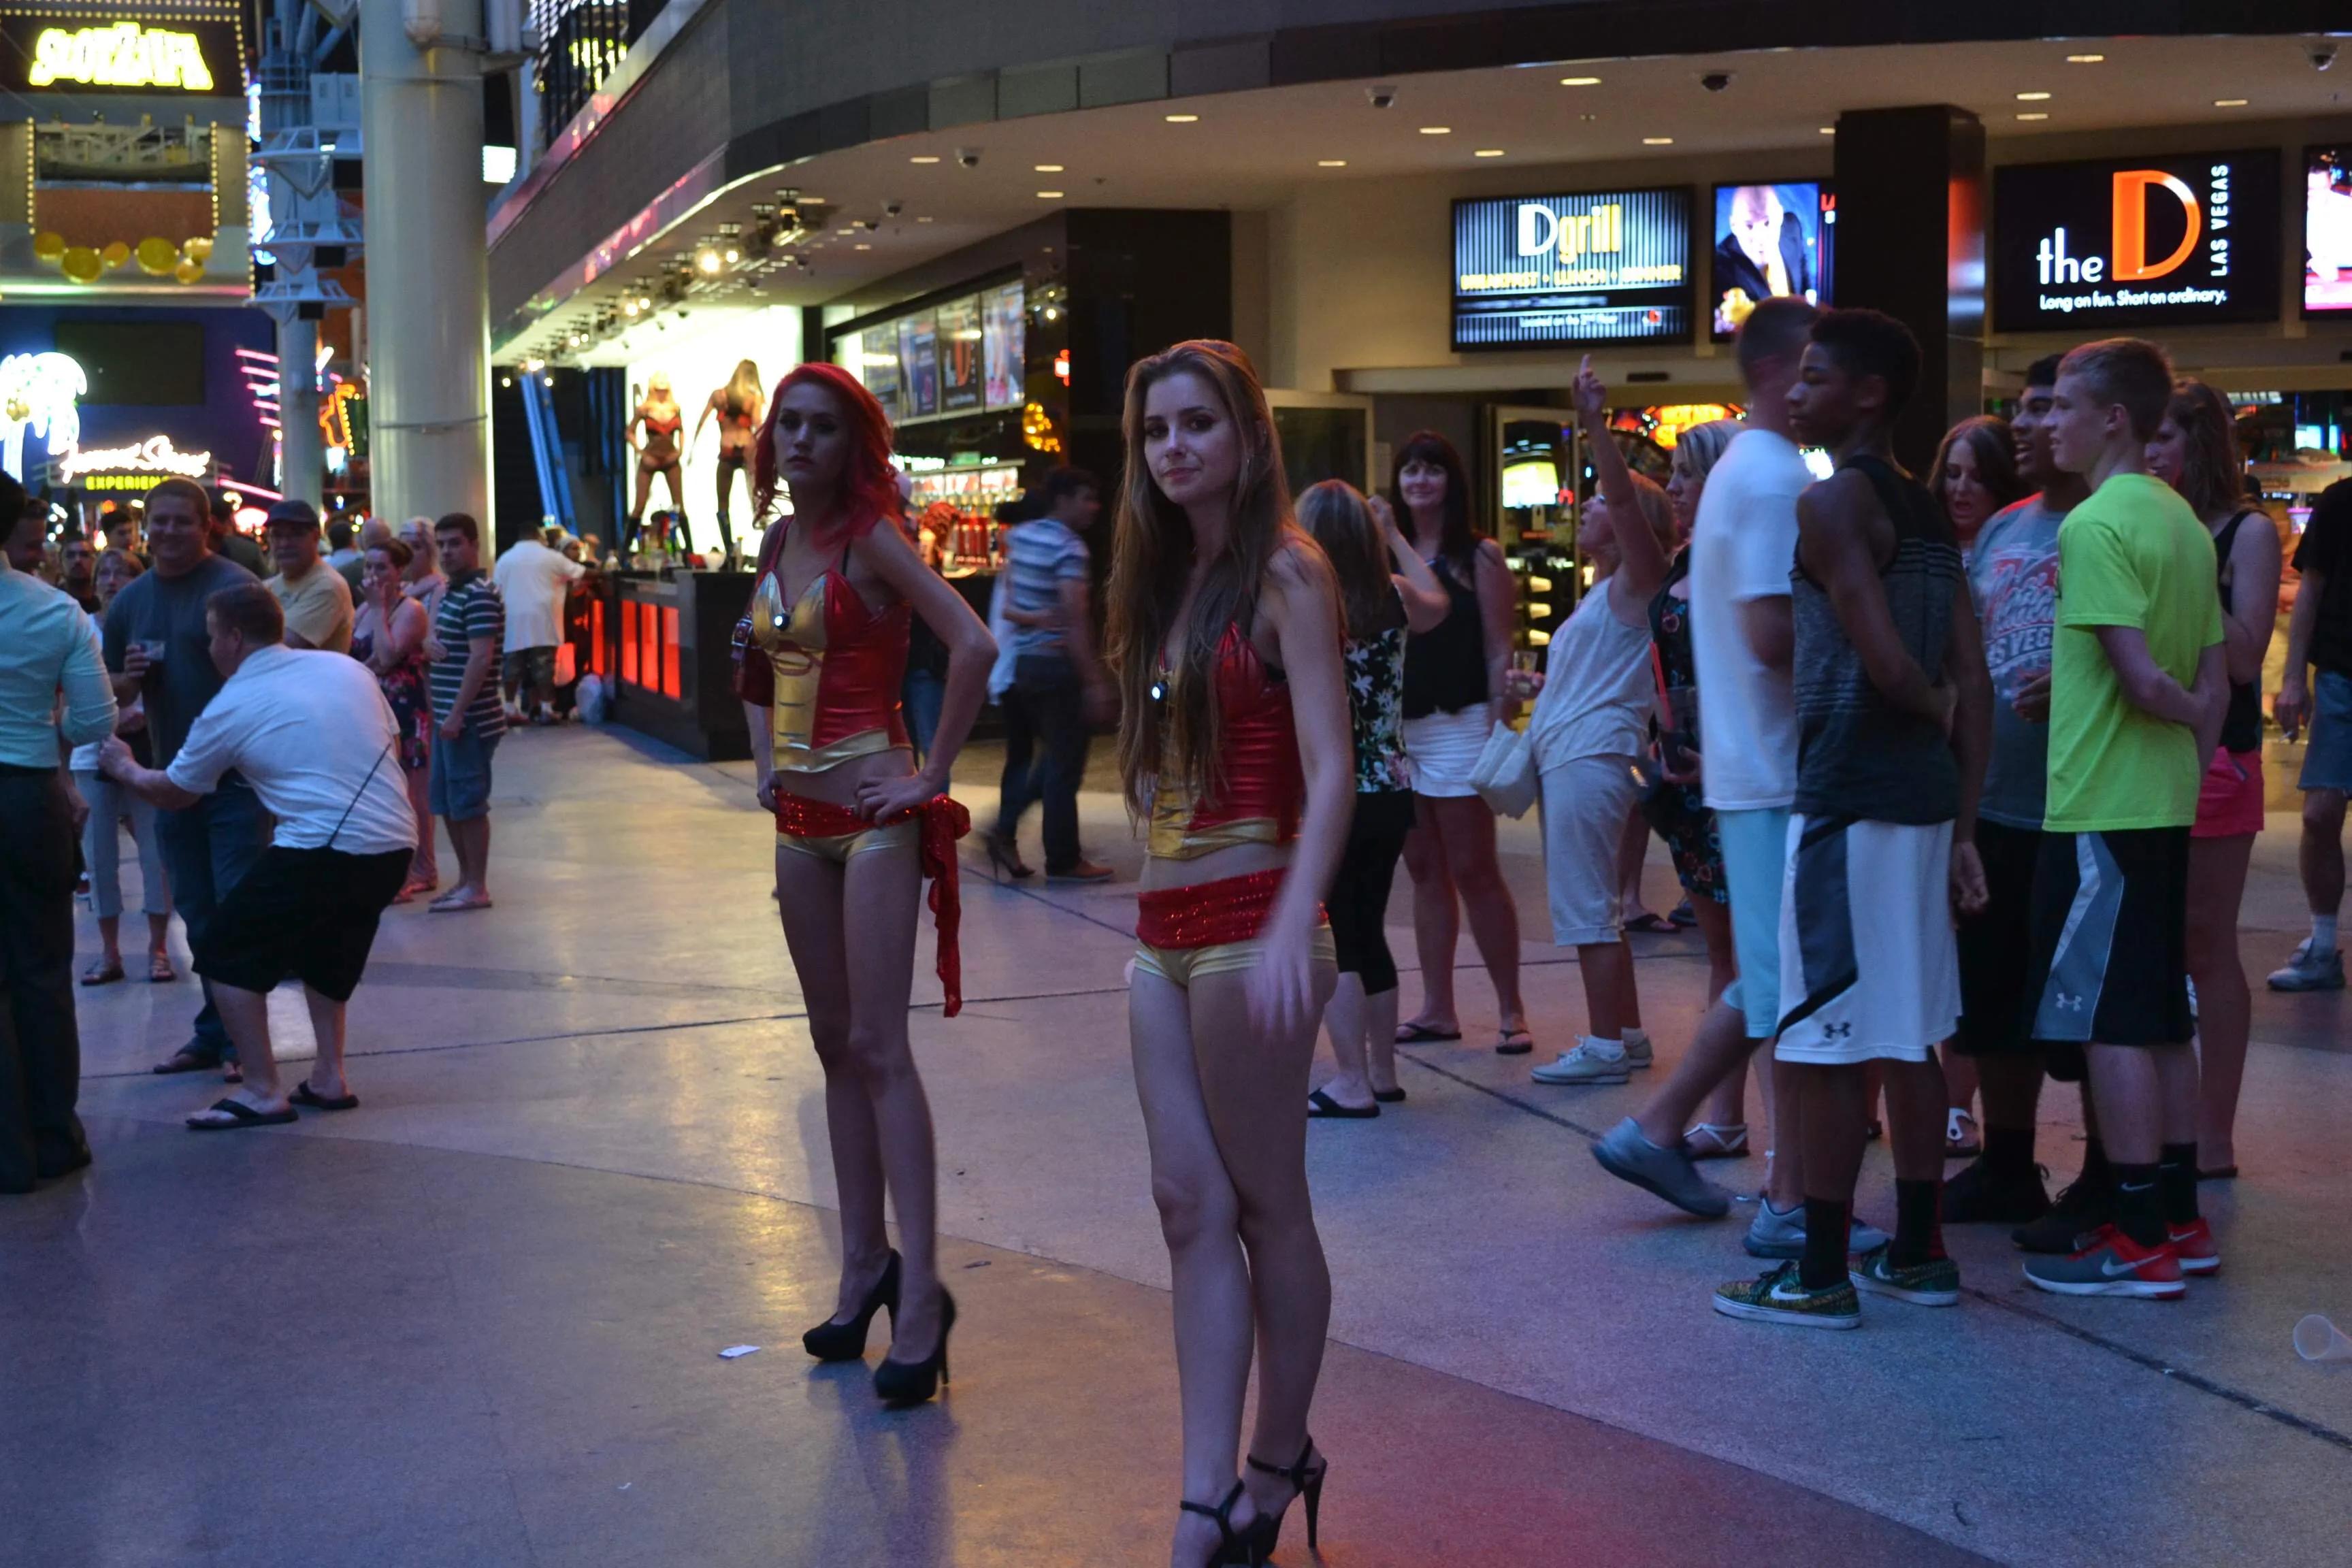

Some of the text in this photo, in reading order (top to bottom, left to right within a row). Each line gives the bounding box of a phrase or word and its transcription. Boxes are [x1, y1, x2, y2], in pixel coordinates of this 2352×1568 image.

[2036, 170, 2201, 284] the D
[2210, 165, 2229, 276] LAS VEGAS
[1554, 268, 1607, 286] LUNCH
[2040, 287, 2227, 312] Long on fun. Short on ordinary.
[85, 476, 168, 490] EXPERIEN
[2010, 627, 2051, 655] VEG
